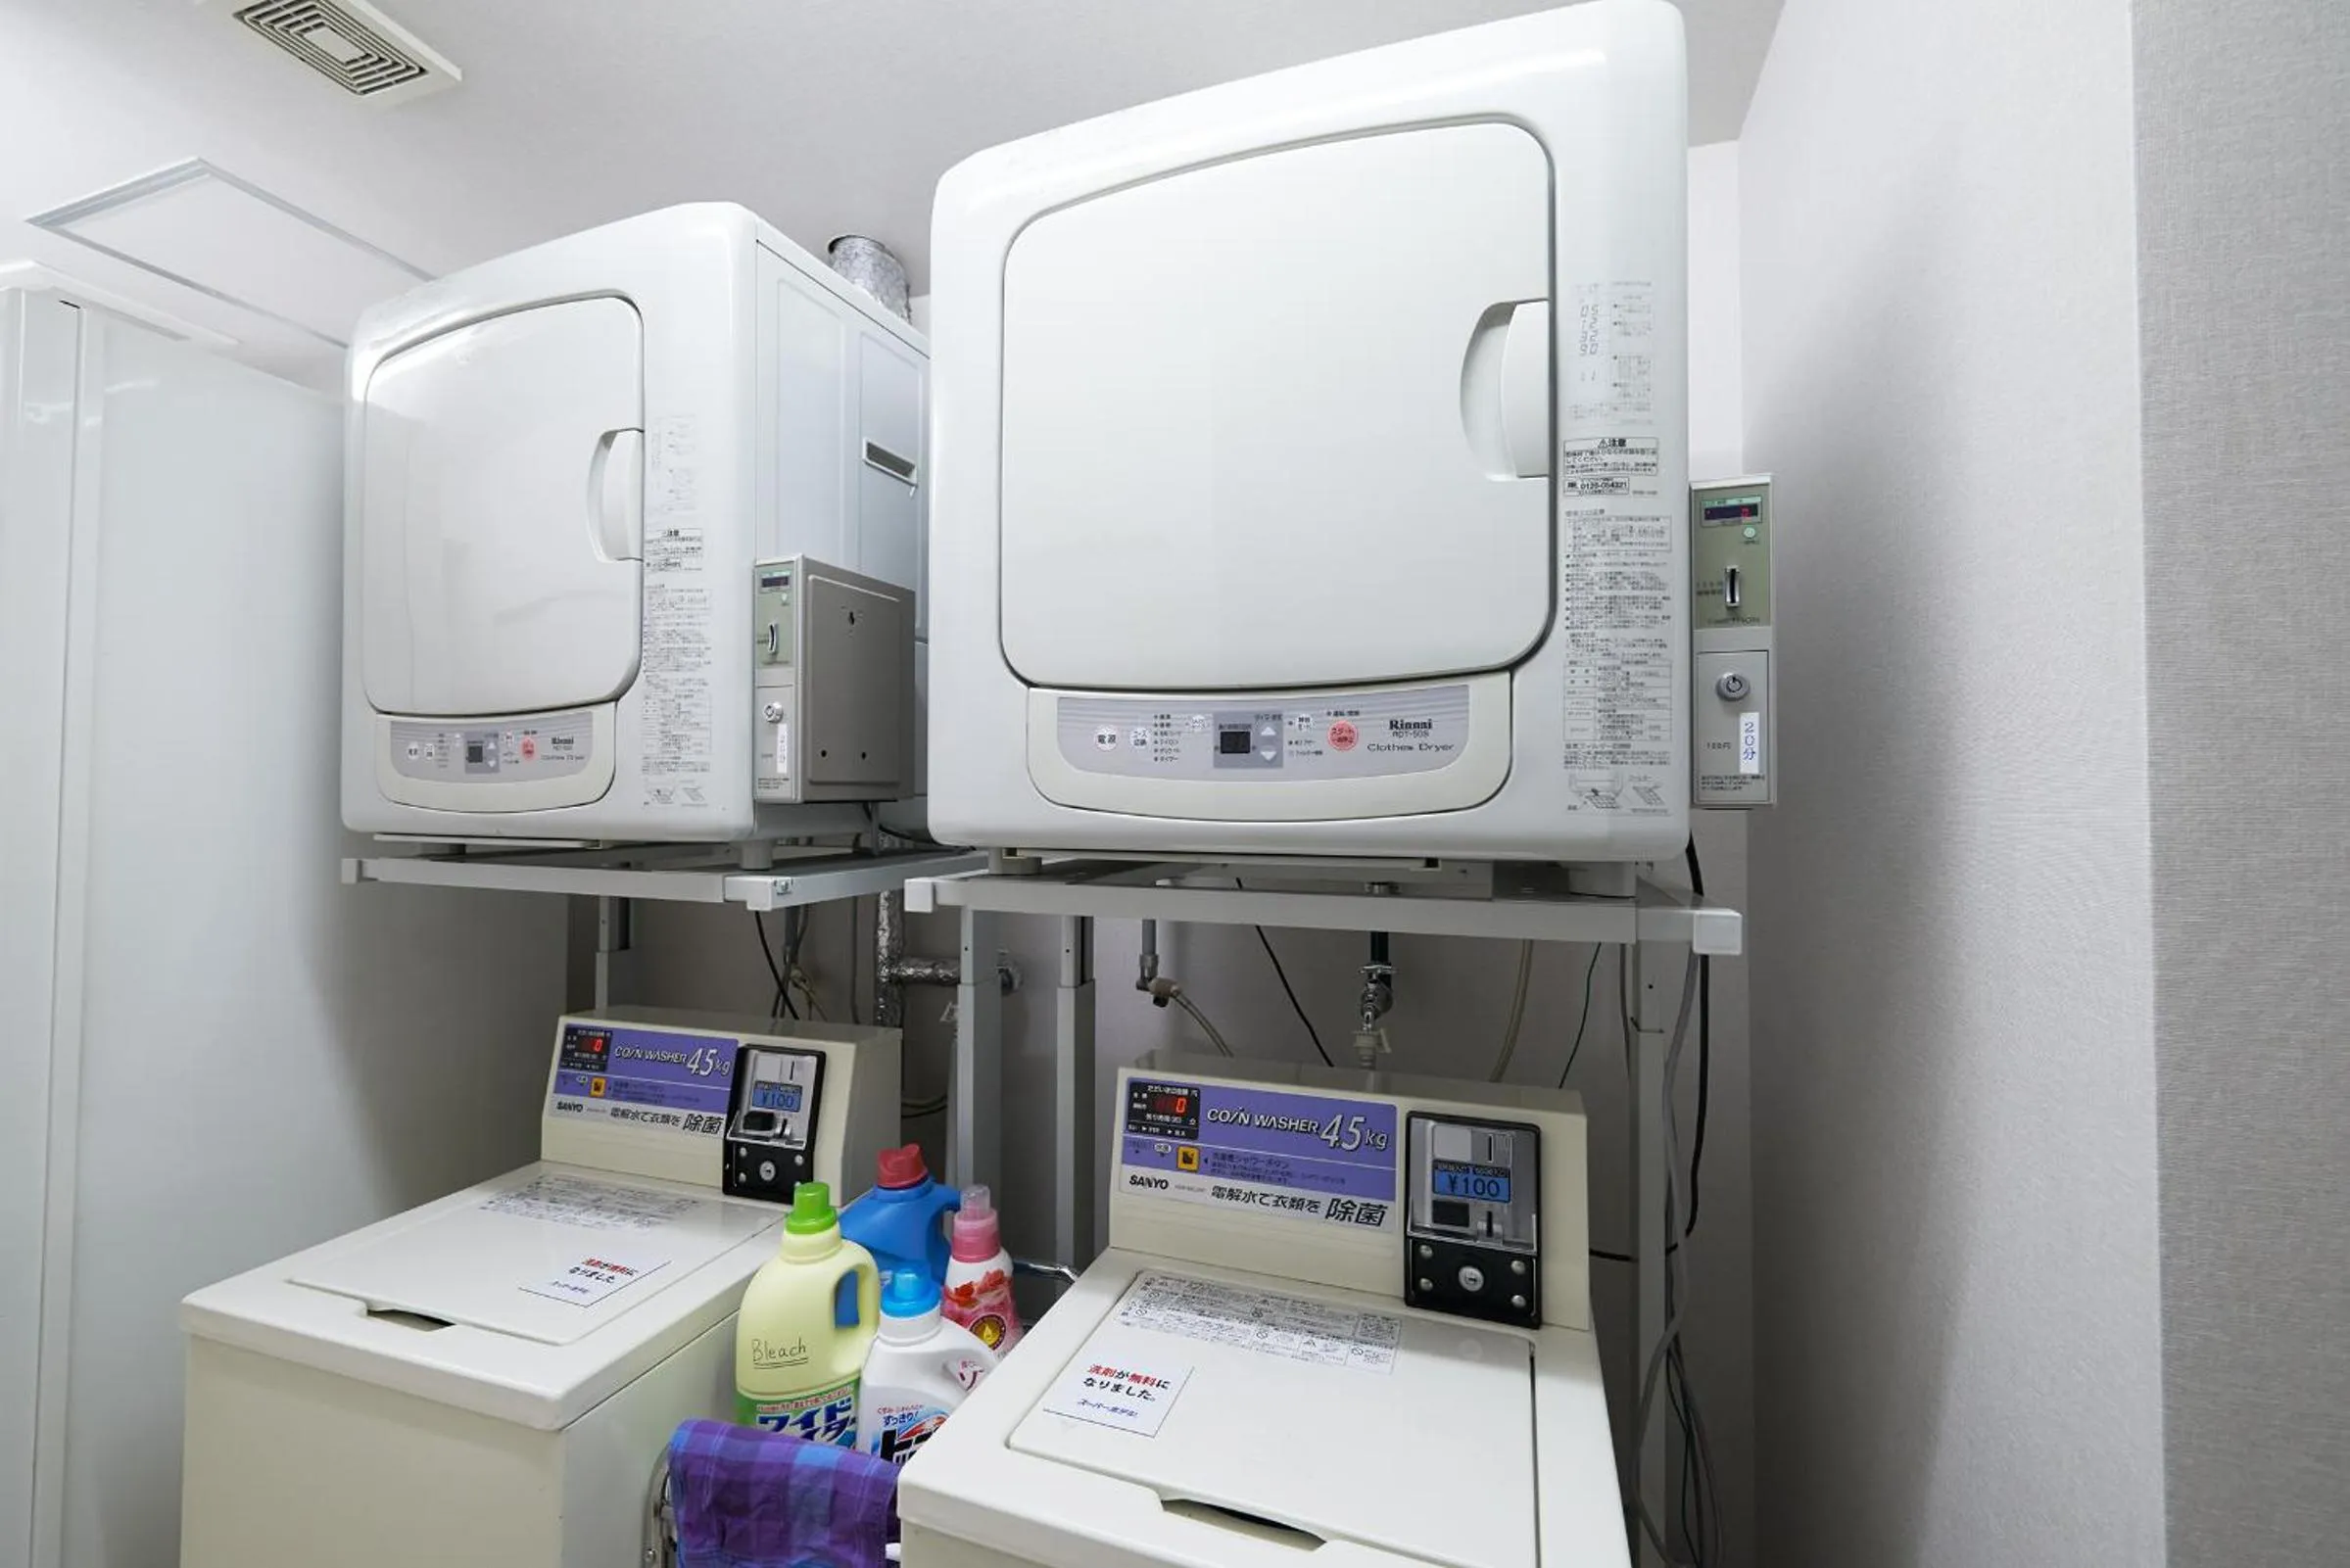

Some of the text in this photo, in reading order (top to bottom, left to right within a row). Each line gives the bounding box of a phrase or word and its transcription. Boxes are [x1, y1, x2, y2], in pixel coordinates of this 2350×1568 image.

[1389, 719, 1432, 730] Rinnai
[552, 736, 574, 745] Rinnai
[1098, 734, 1116, 744] 電源
[1367, 742, 1455, 752] Clothes Dryer
[1744, 722, 1755, 760] 20分
[595, 1039, 603, 1052] 0
[614, 1045, 642, 1058] COIN
[645, 1051, 688, 1064] WASHER
[556, 1101, 584, 1113] SANYO
[1175, 1097, 1187, 1114] 0
[683, 1113, 725, 1135] 除菌
[1207, 1107, 1251, 1126] COIN
[1254, 1114, 1319, 1133] WASHER
[1128, 1174, 1169, 1190] SANYO
[1449, 1174, 1500, 1197] ¥100
[1211, 1184, 1388, 1227] 電解水で衣類を 除菌
[751, 1336, 806, 1362] Bleach
[1087, 1363, 1171, 1390] 洗剤が無料に
[1083, 1377, 1156, 1402] なりました。
[758, 1397, 852, 1432] ワイド
